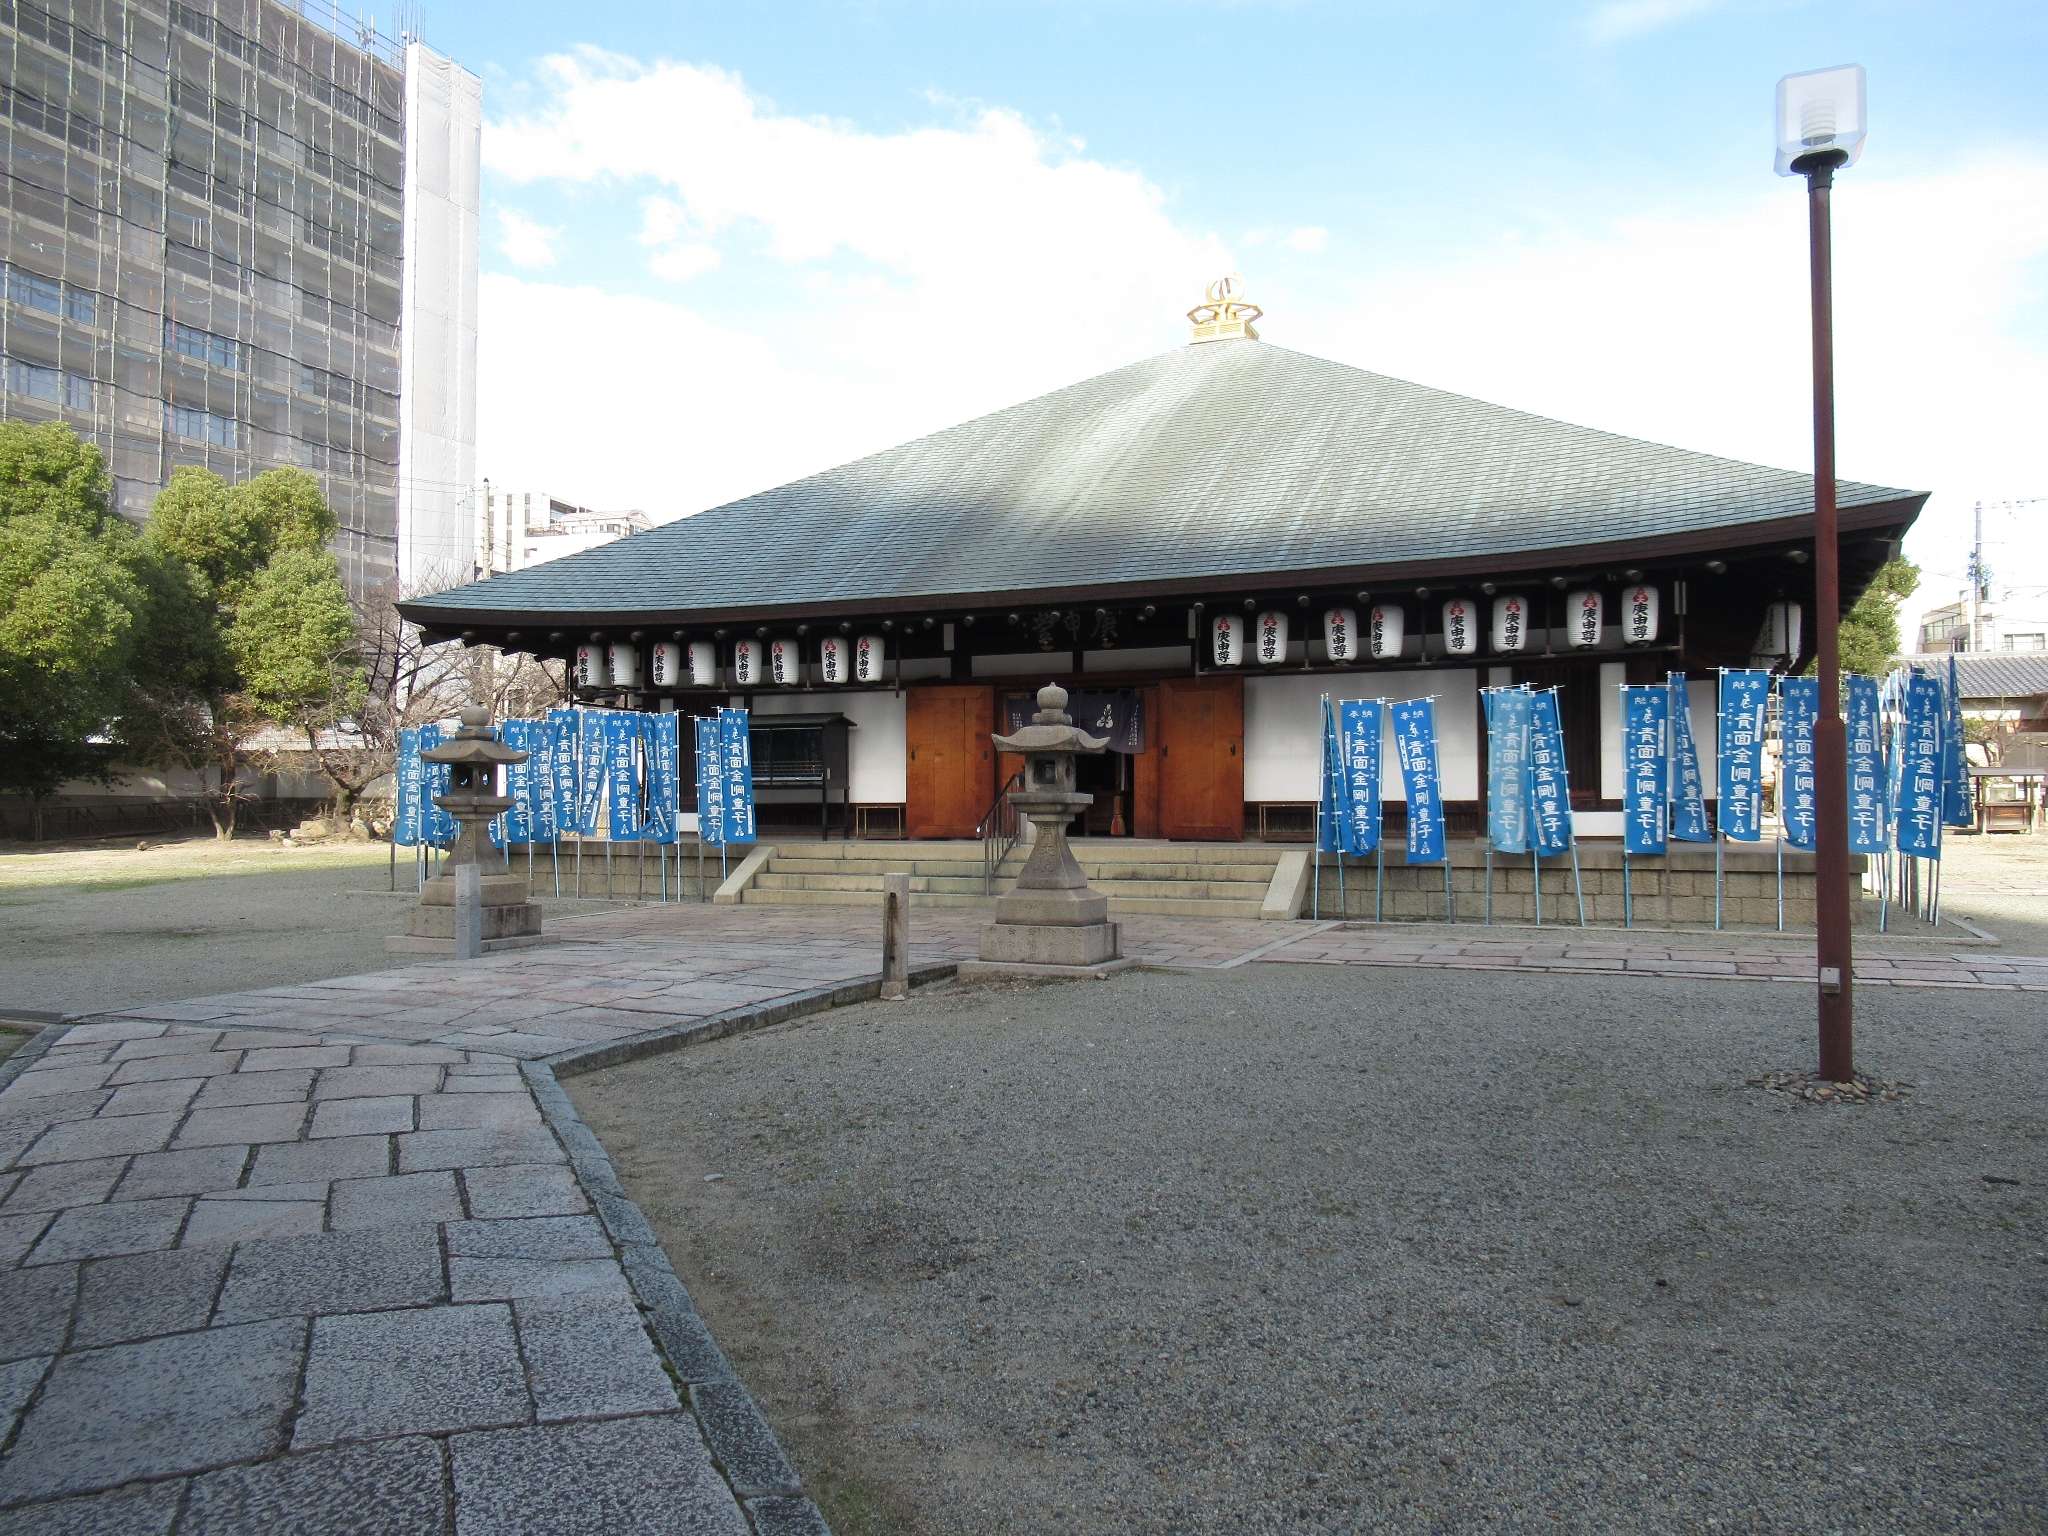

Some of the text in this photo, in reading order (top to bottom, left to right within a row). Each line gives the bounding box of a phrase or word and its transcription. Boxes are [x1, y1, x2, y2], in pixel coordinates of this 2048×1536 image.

[1450, 615, 1465, 650] 庚申尊
[1504, 612, 1520, 647] 庚申尊
[1582, 608, 1597, 642] 庚申尊
[1632, 602, 1648, 638] 庚申尊
[1217, 630, 1230, 662] 庚申尊
[1263, 626, 1277, 659] 庚申尊
[1332, 624, 1346, 657] 庚申尊
[1373, 621, 1383, 654] 庚申尊
[825, 651, 837, 680] 庚申尊
[859, 649, 870, 679] 庚申尊
[1348, 710, 1374, 719] 奉納
[1400, 710, 1425, 720] 奉納
[1352, 739, 1370, 834] 青面金剛童子
[1408, 740, 1432, 839] 青面金剛童子
[1532, 733, 1562, 832] 青面金剛童子
